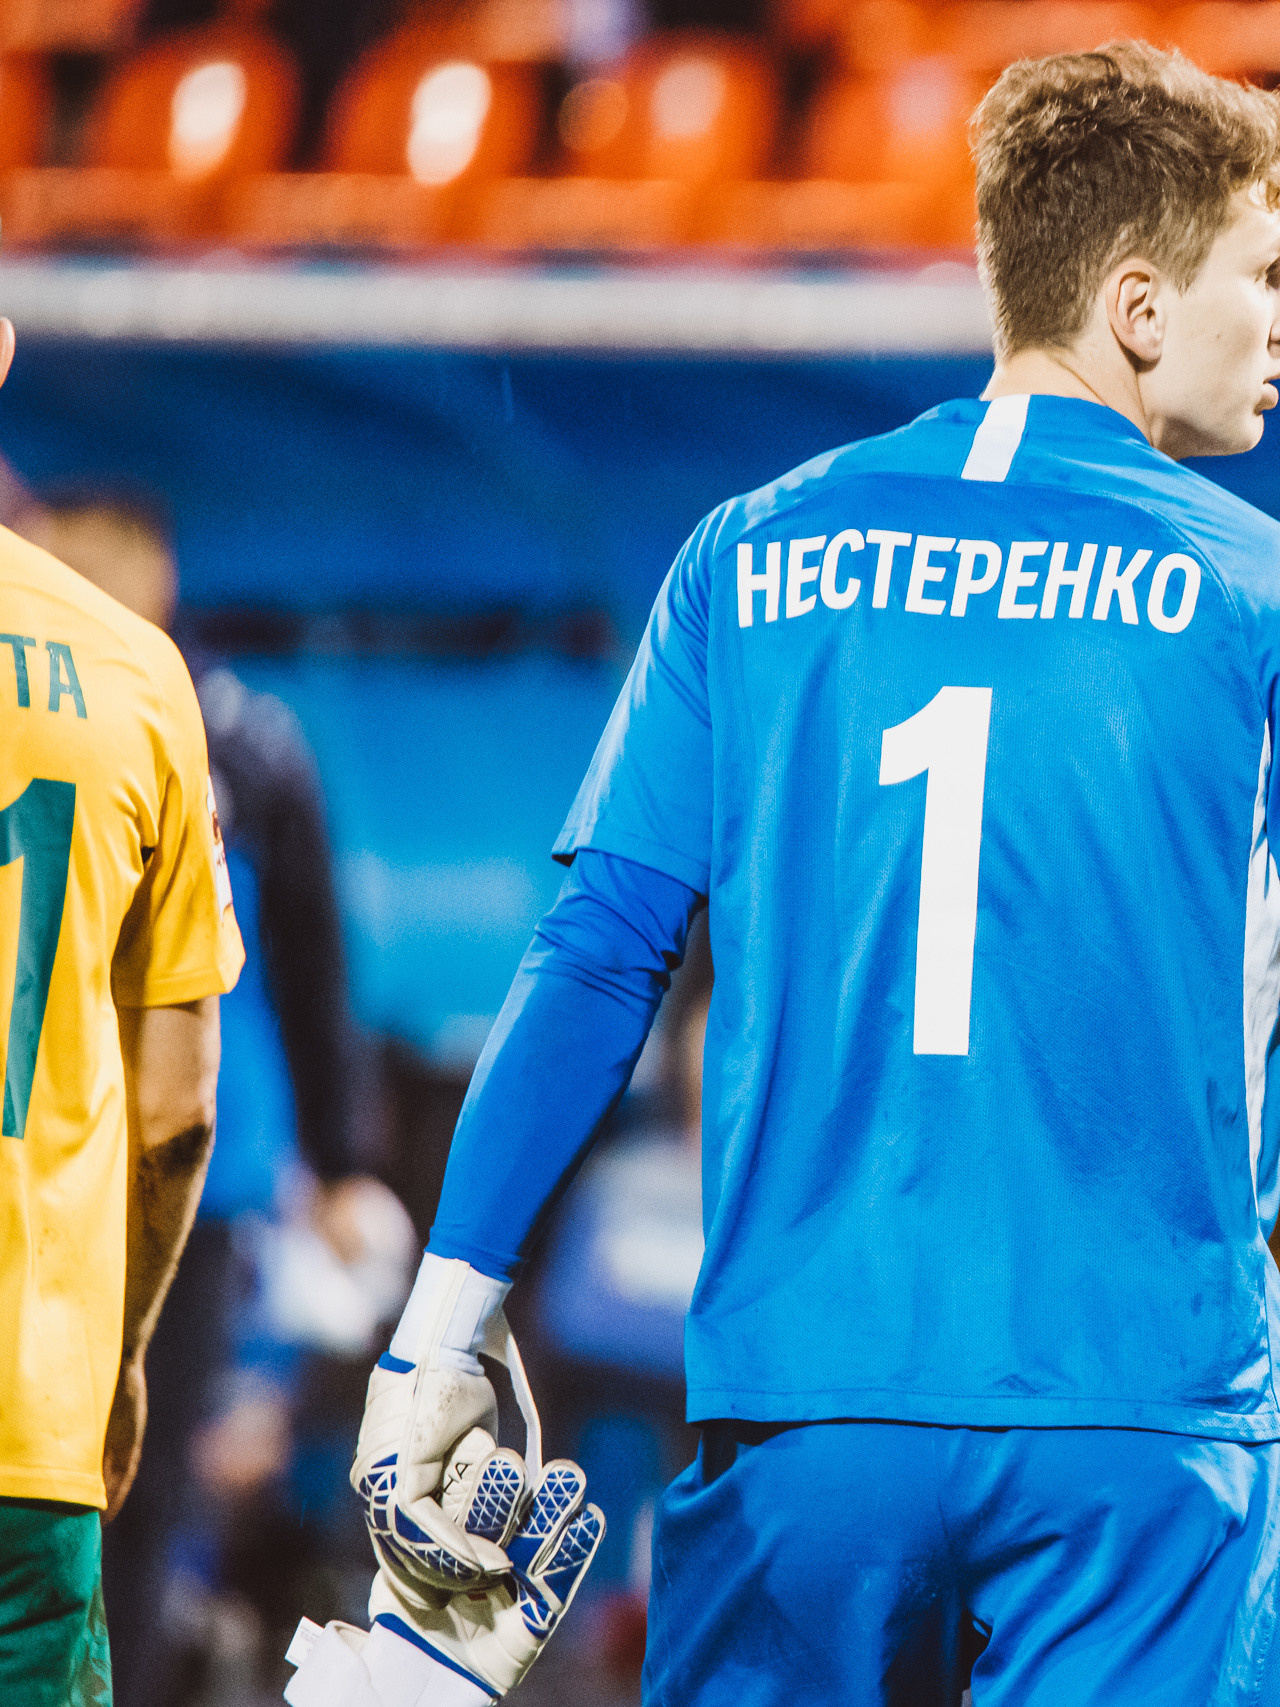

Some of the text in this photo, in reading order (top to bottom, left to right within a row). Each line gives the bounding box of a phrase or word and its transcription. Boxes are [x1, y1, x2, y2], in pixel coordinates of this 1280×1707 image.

[737, 529, 1201, 634] НЕСТЕРЕНКО
[0, 778, 76, 1139] 1
[879, 686, 993, 1056] 1
